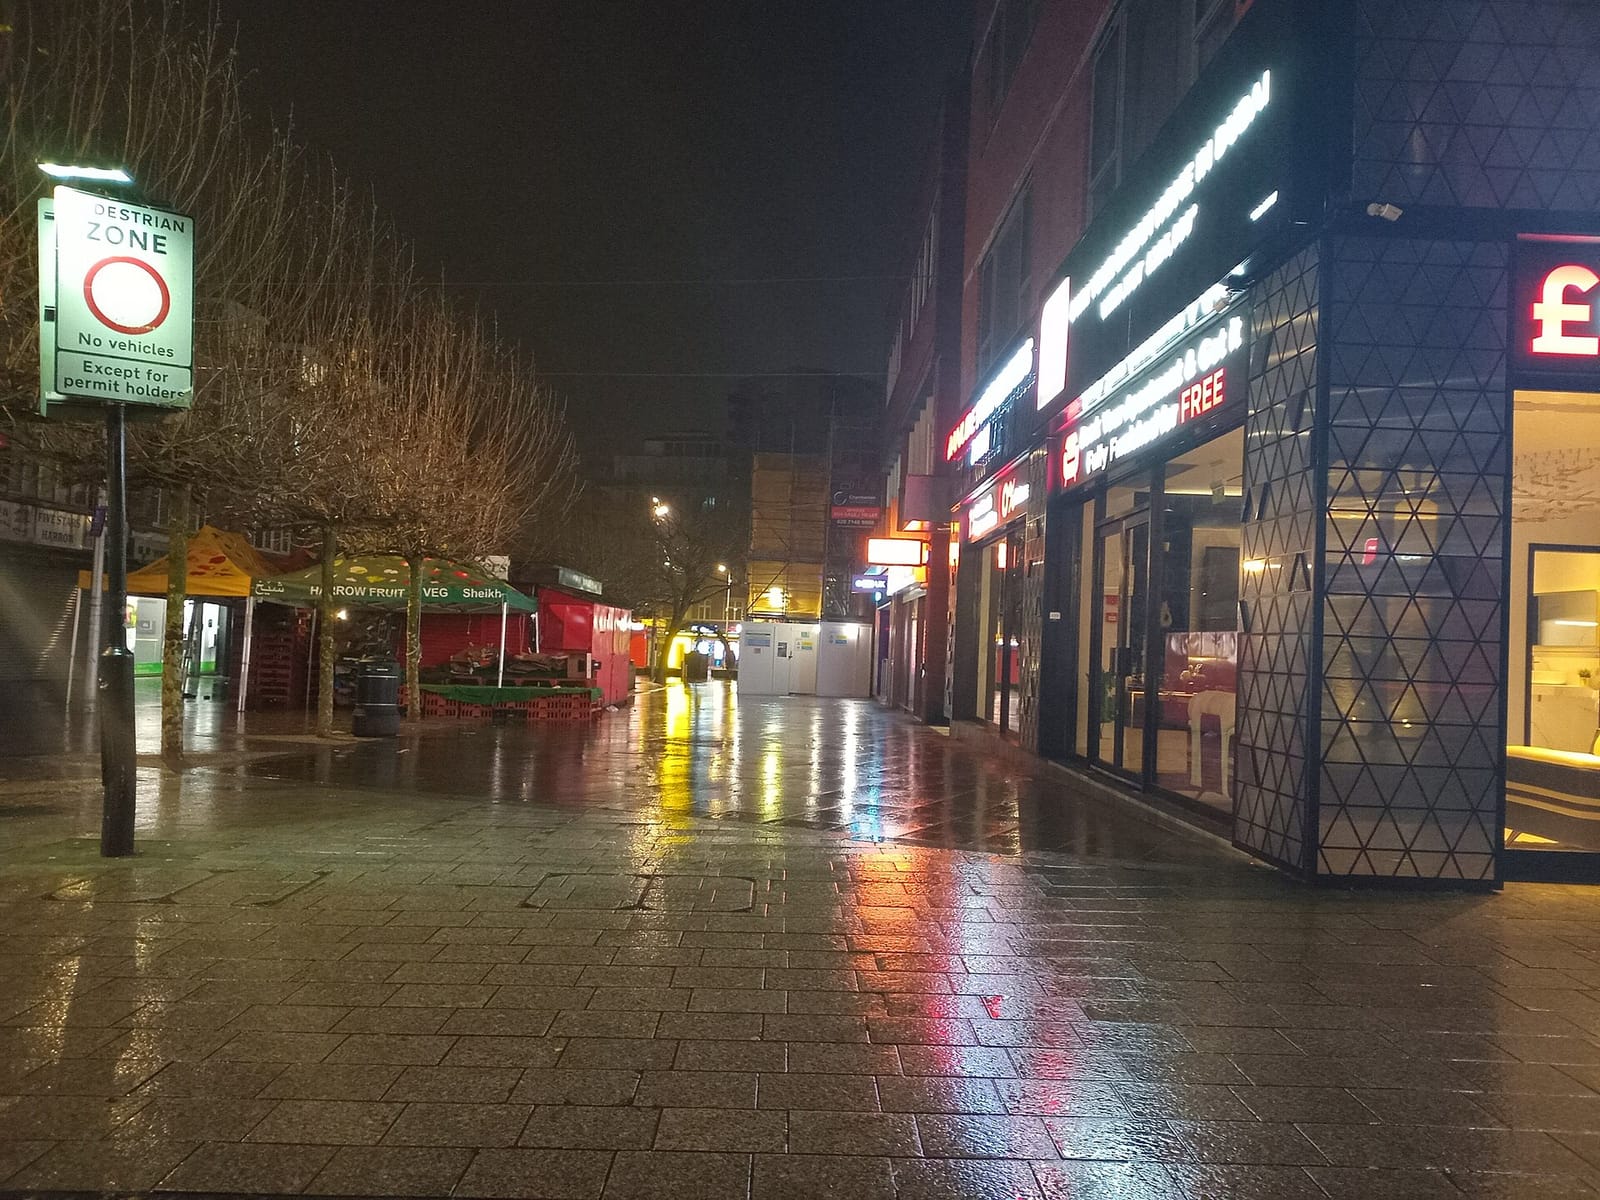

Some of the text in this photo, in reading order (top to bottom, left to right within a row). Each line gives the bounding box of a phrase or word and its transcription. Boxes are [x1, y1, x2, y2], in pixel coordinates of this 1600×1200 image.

[94, 203, 185, 234] DESTRIAN
[87, 221, 168, 255] ZONE
[78, 332, 175, 358] No vehicles
[83, 360, 169, 383] Except for
[63, 376, 186, 400] permit holders
[1180, 368, 1224, 424] FREE
[369, 587, 406, 599] FRUIT
[422, 587, 449, 598] VEG
[462, 588, 502, 599] Sheikh
